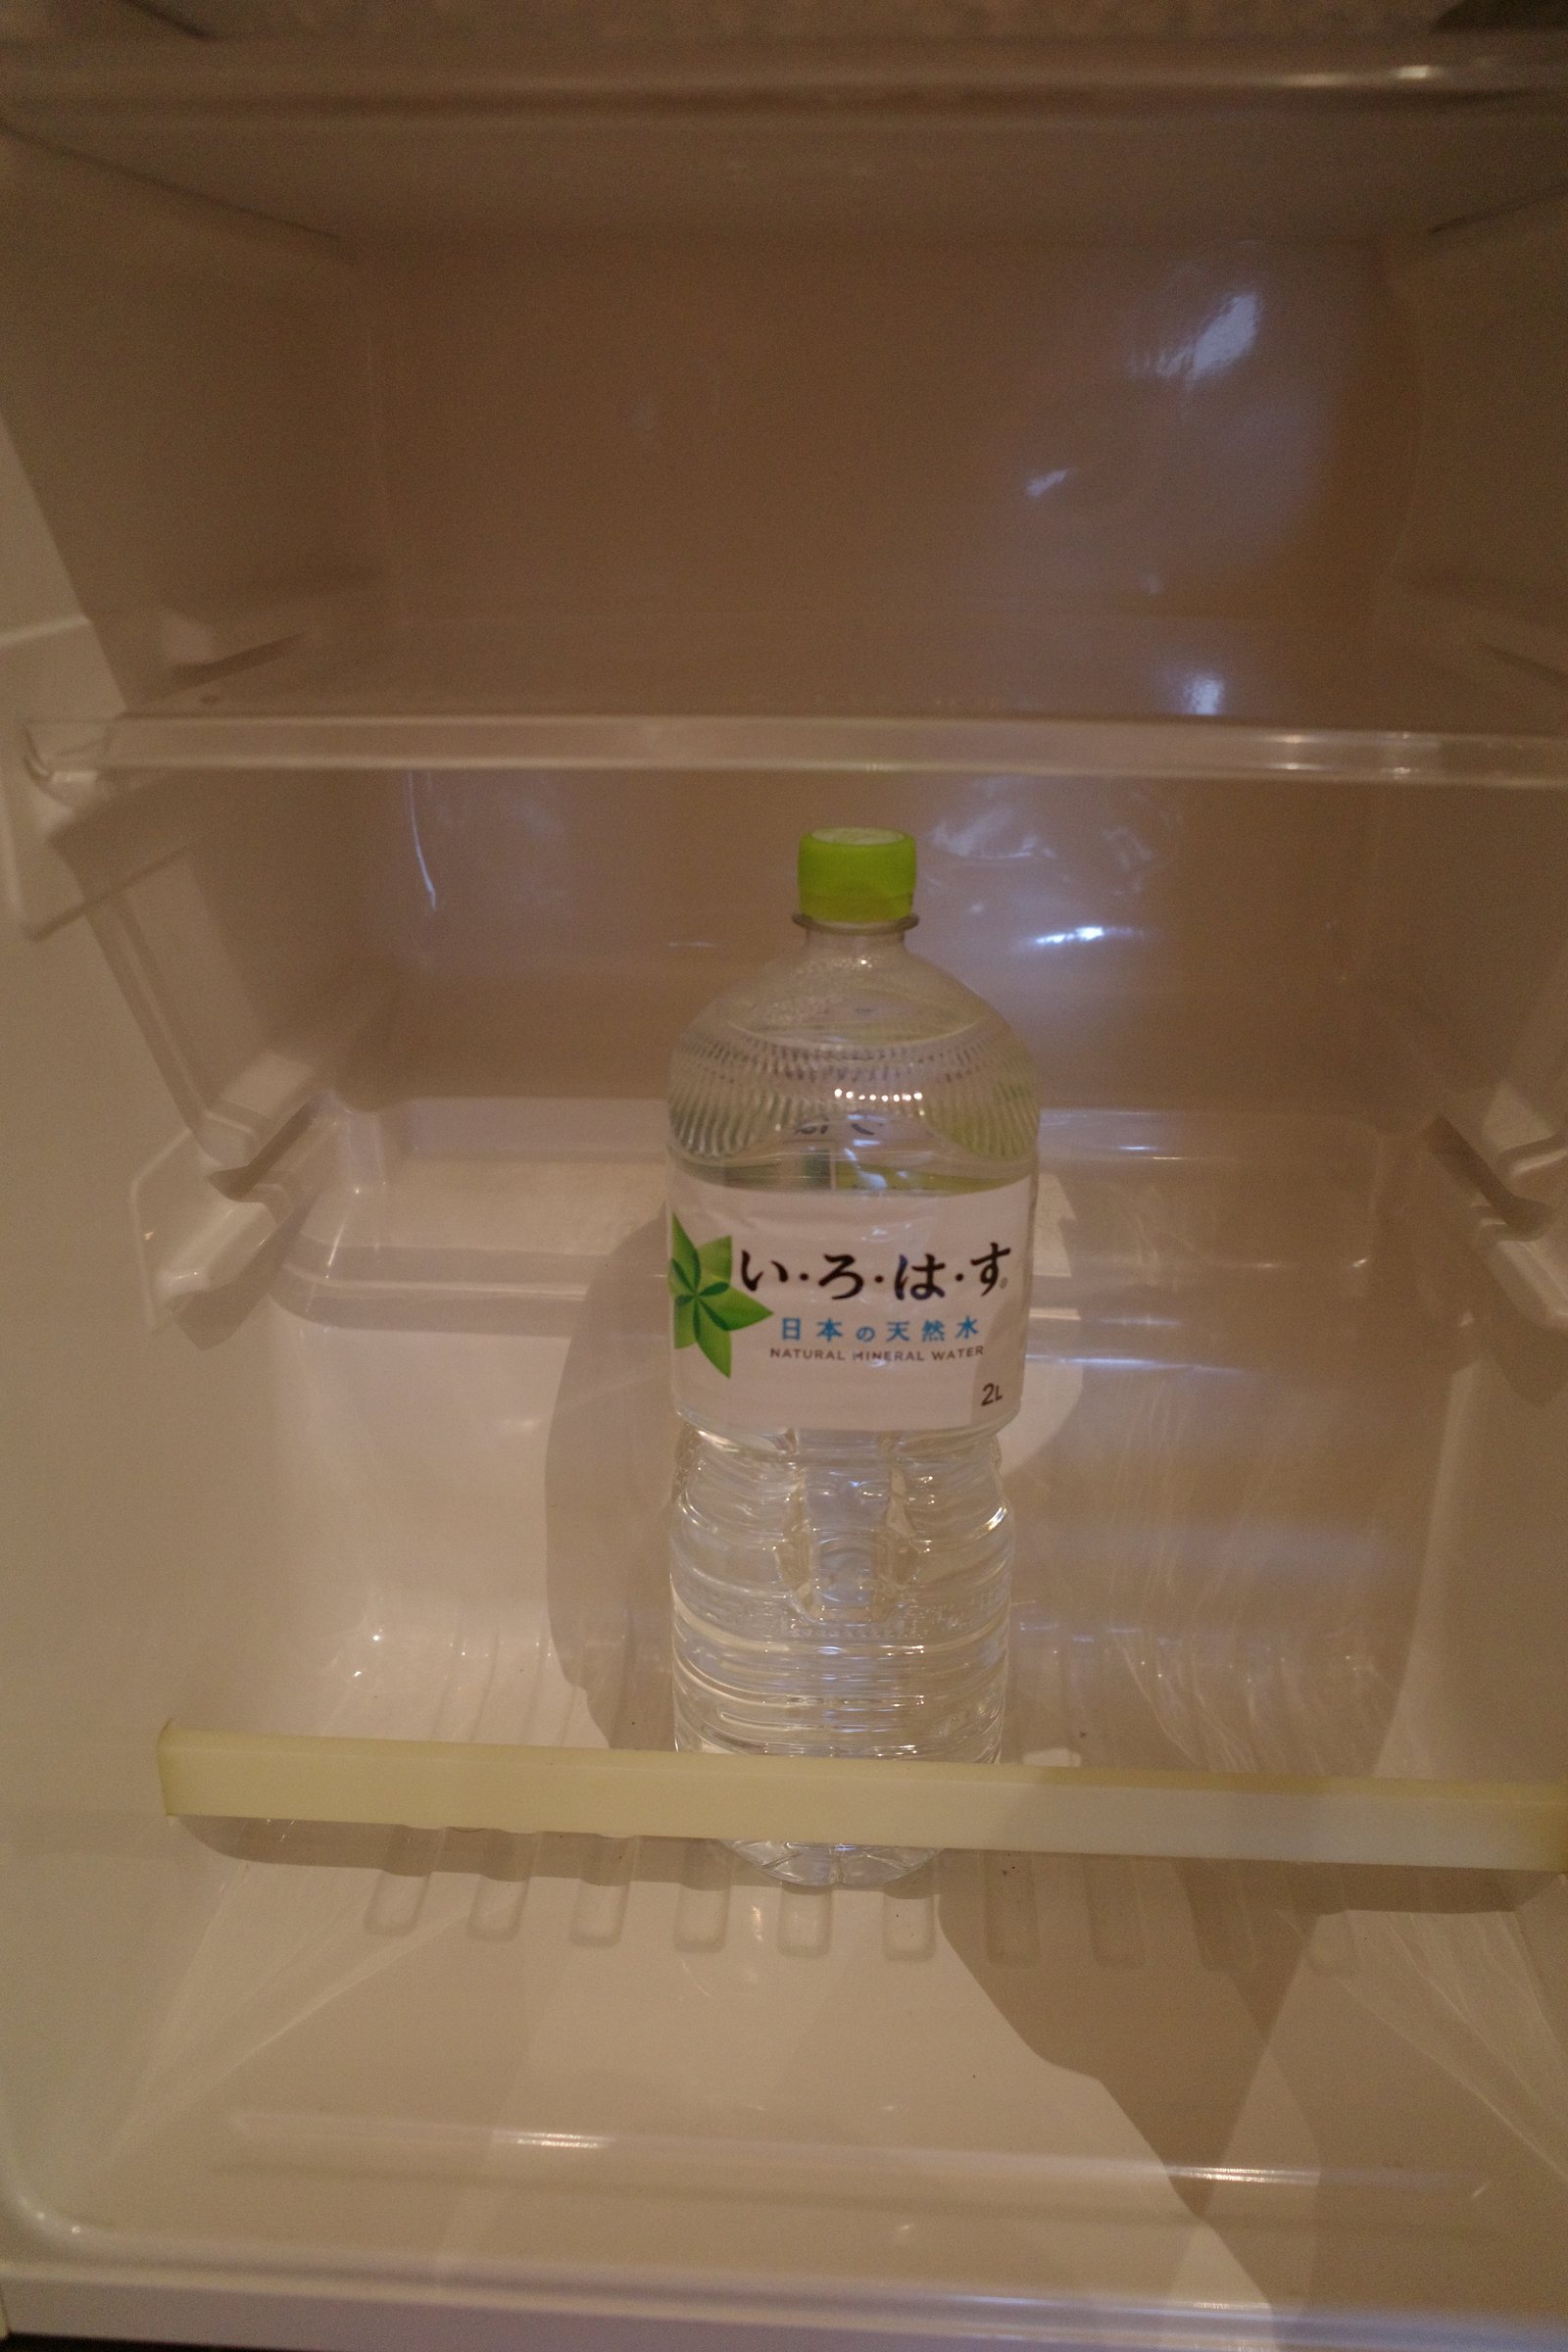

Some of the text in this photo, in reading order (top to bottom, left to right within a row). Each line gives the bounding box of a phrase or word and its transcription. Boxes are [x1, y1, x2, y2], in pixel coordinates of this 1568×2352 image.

[781, 1315, 979, 1343] 日本の天然水
[769, 1345, 985, 1362] NATURAL MINERAL WATER
[981, 1382, 1004, 1406] 2L
